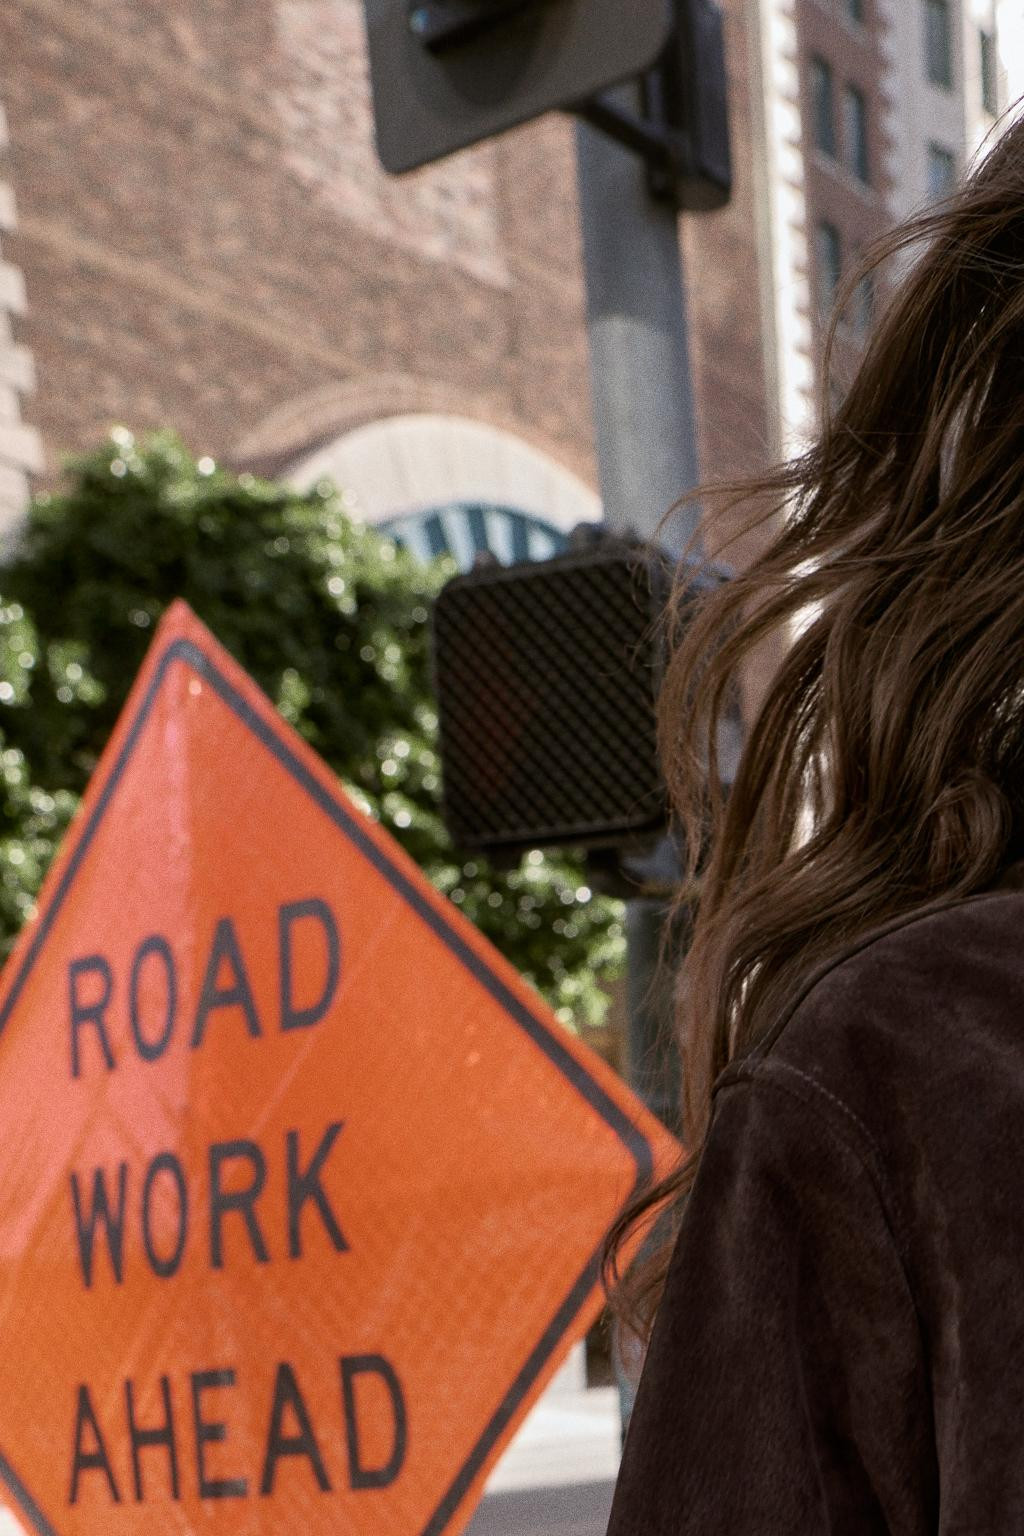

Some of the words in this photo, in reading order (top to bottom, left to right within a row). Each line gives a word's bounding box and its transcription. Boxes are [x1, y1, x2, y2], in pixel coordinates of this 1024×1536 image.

[68, 897, 343, 1077] ROAD
[70, 1121, 350, 1288] WORK
[68, 1353, 409, 1505] AHEAD
